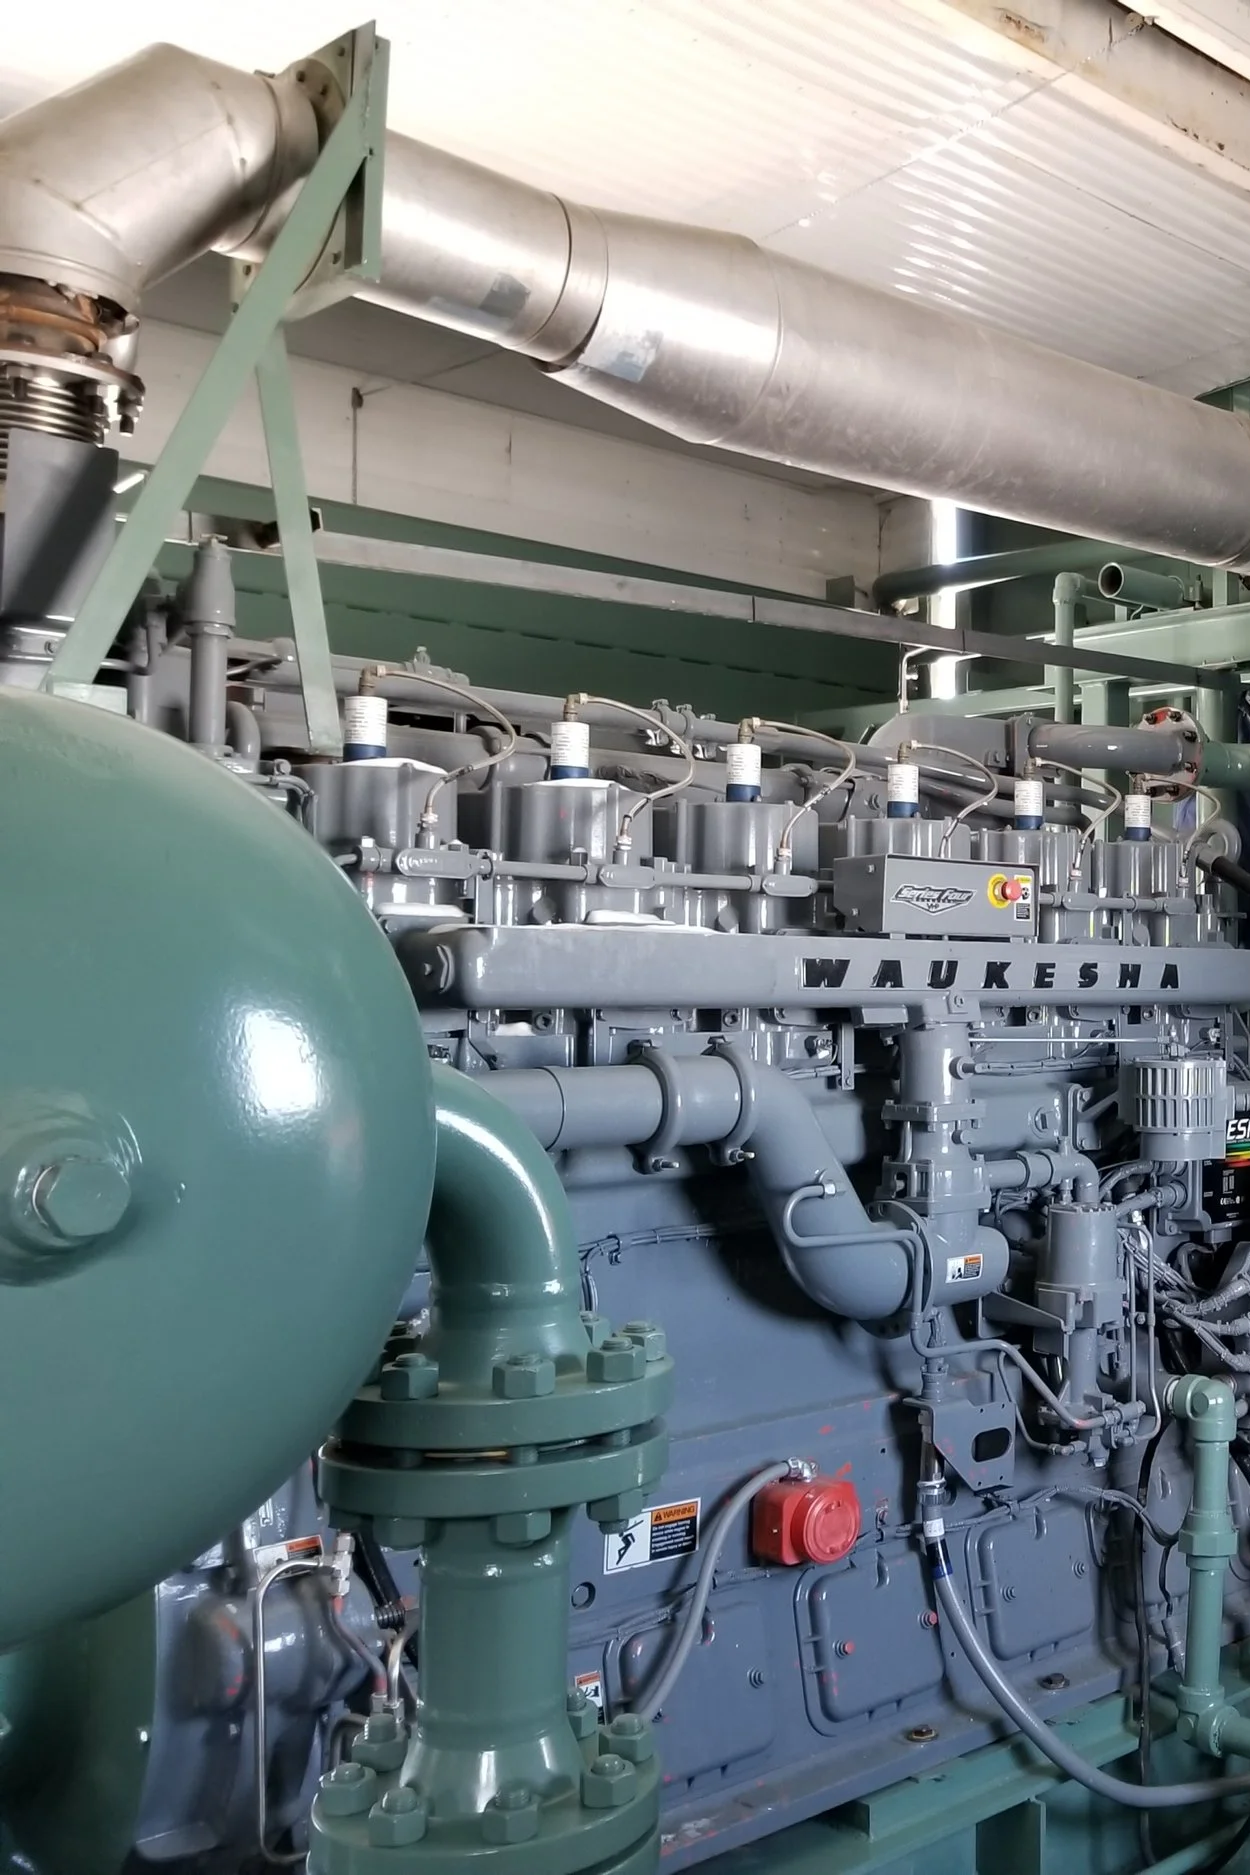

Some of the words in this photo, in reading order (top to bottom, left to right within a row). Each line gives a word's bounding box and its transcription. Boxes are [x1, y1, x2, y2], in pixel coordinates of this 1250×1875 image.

[898, 886, 942, 899] Series
[941, 888, 973, 902] Four
[801, 957, 1181, 991] WAUKESHA
[663, 1505, 695, 1518] WARNING
